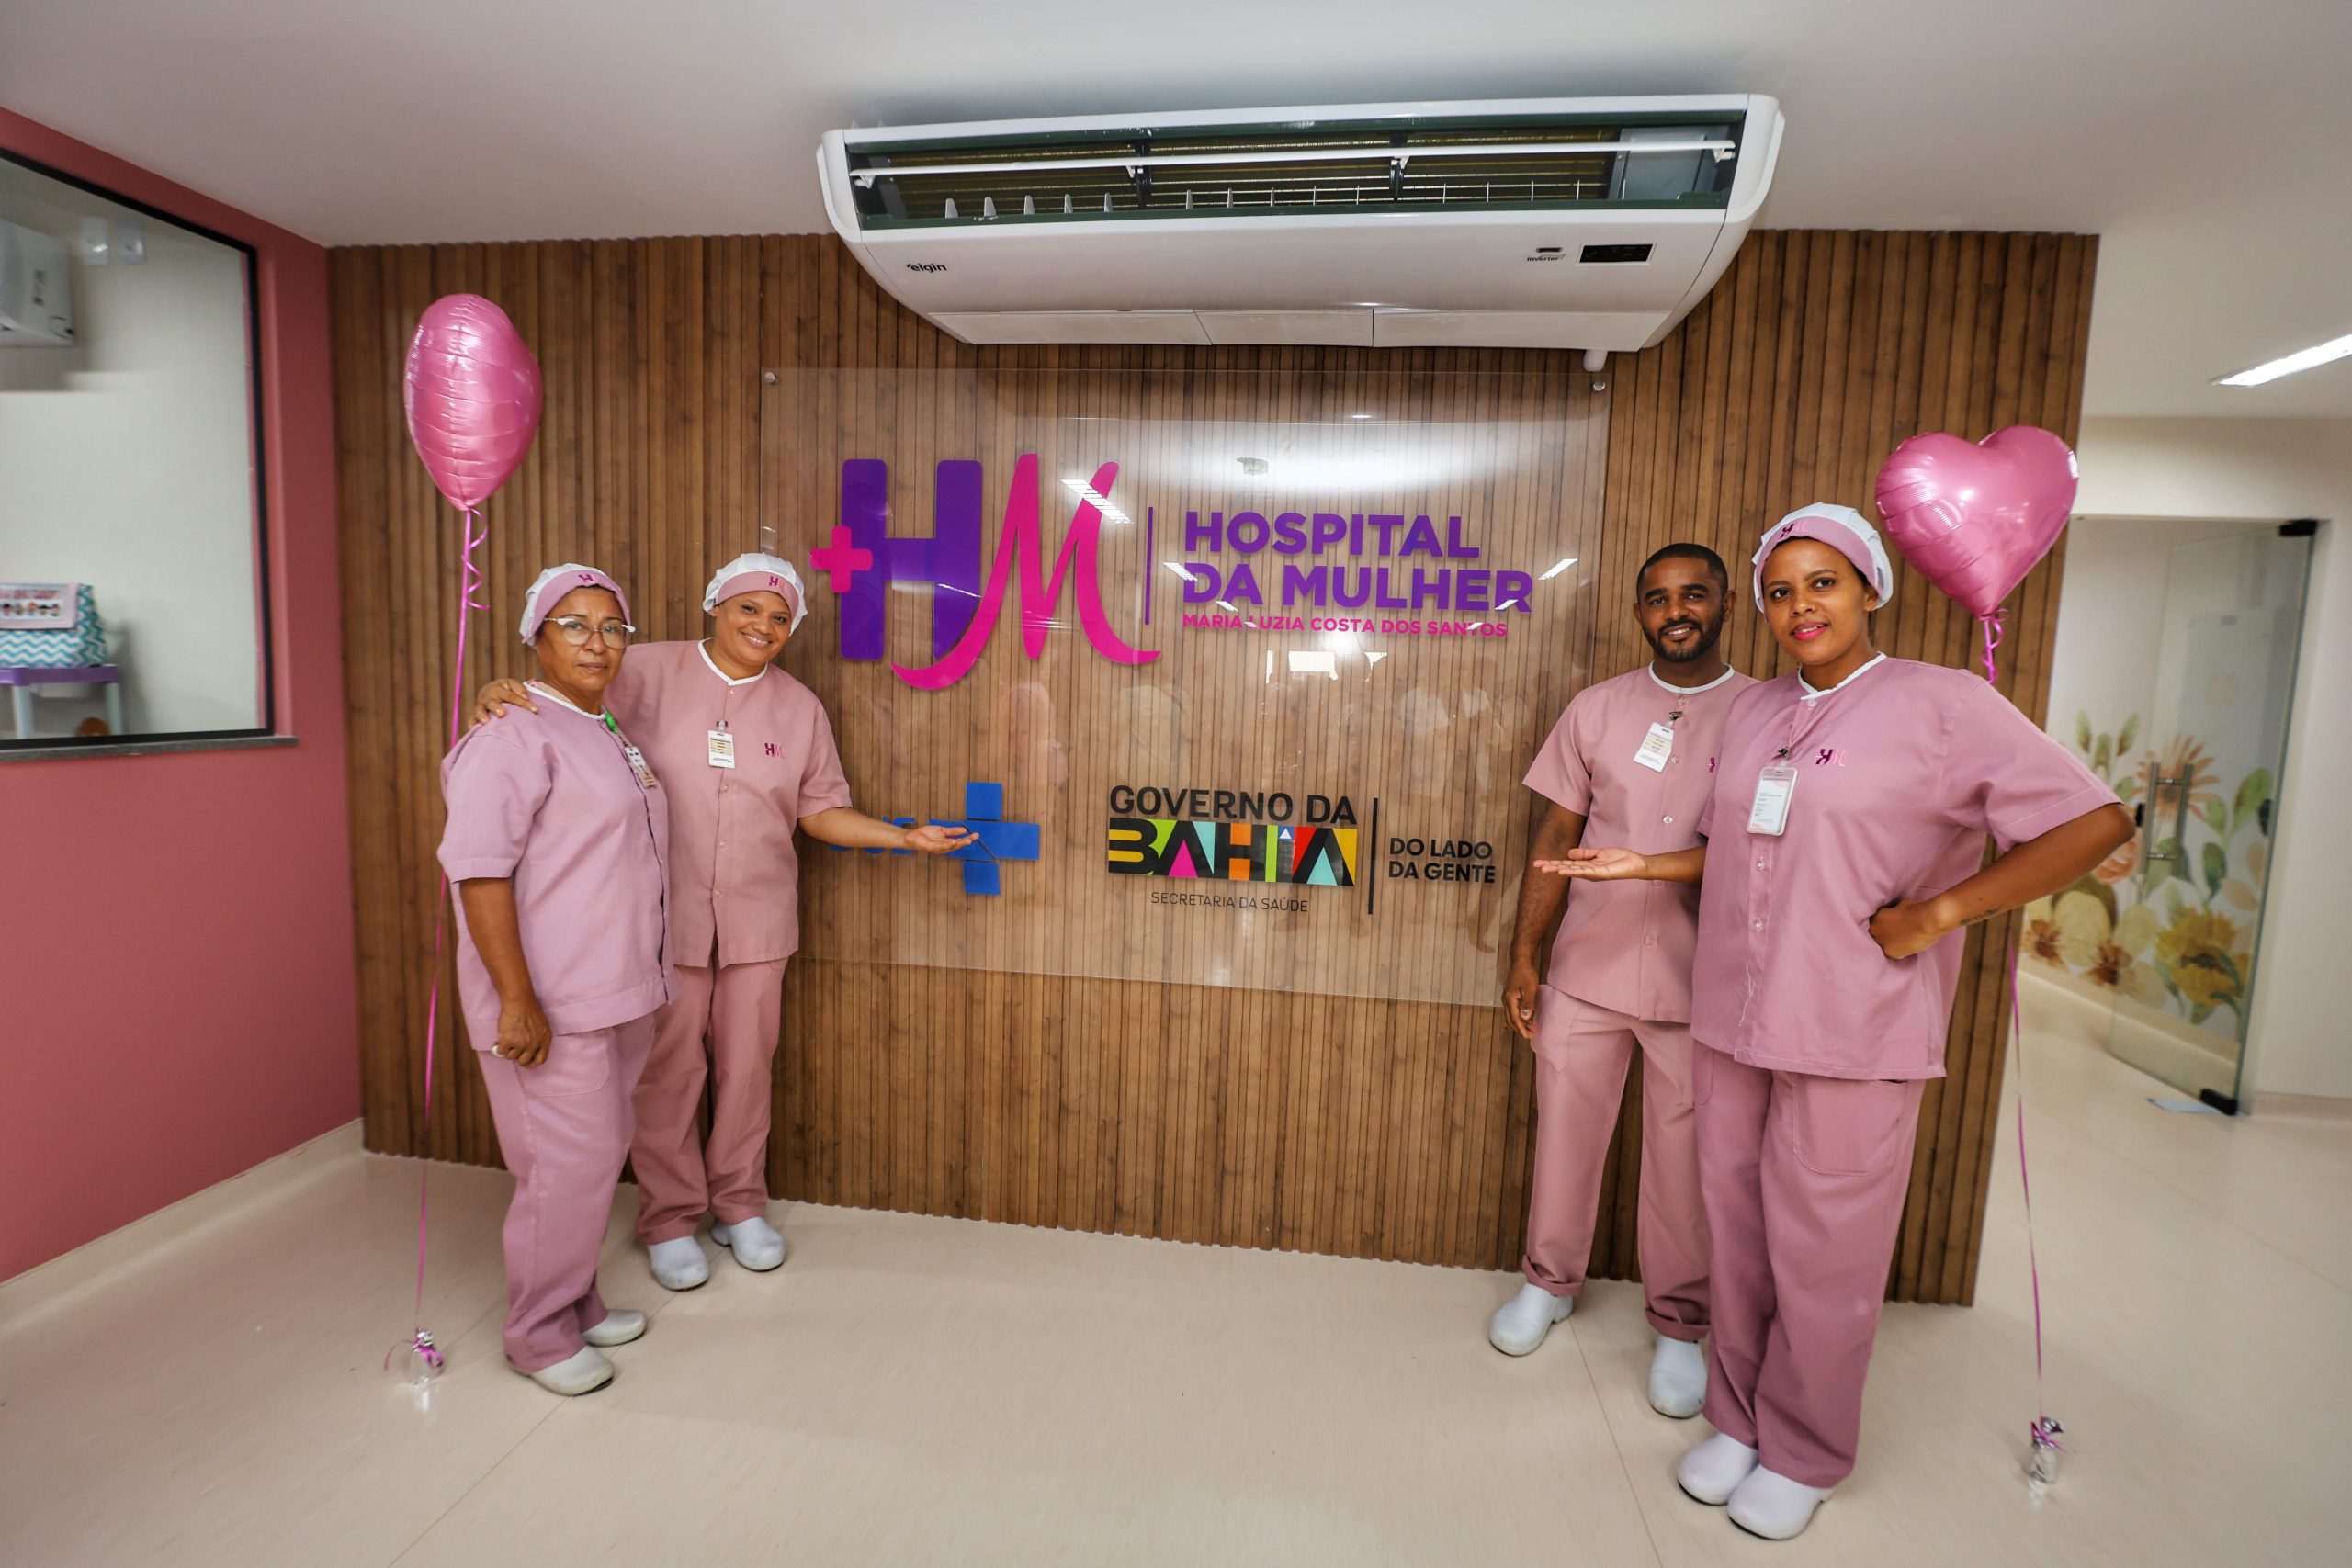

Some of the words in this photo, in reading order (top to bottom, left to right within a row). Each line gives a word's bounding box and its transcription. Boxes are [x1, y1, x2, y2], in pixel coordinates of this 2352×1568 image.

[1184, 511, 1480, 559] HOSPITAL
[1182, 562, 1263, 606] DA
[1282, 564, 1533, 613] MULHER
[1182, 614, 1242, 628] MARIA
[1310, 617, 1375, 633] COSTA
[1381, 619, 1421, 635] DOS
[1427, 621, 1508, 637] SANTOS
[1110, 785, 1294, 820] GOVERNO
[1306, 795, 1357, 825] DA
[1108, 817, 1358, 886] BAHIA
[1390, 837, 1425, 856] DO
[1430, 840, 1493, 860] LADO
[1388, 861, 1419, 879] DA
[1424, 862, 1496, 884] GENTE
[1151, 892, 1235, 908] SECRETARIA
[1239, 897, 1258, 908] DA
[1261, 897, 1308, 912] SAÚDE
